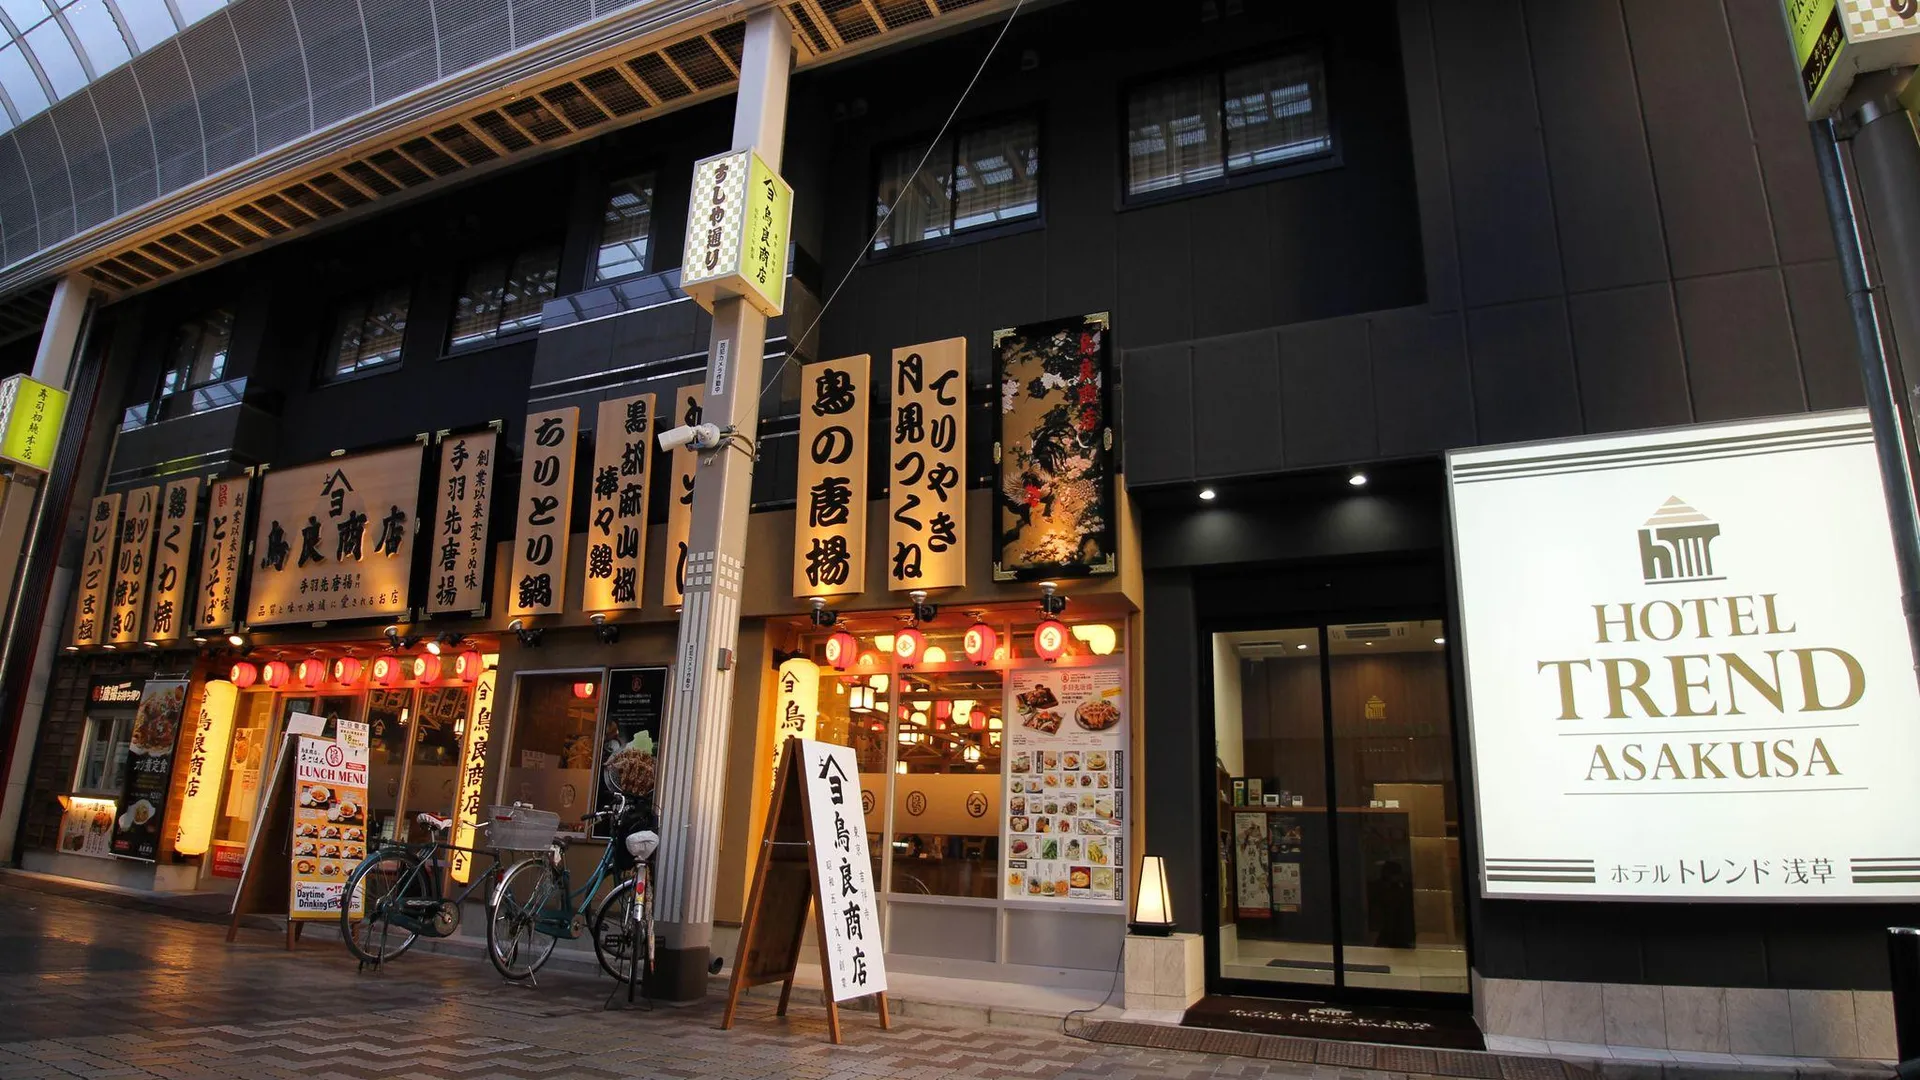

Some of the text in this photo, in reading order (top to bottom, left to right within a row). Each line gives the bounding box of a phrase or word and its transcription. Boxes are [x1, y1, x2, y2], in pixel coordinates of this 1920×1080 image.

[705, 163, 729, 271] すしや通り
[756, 204, 773, 284] 鳥良商店
[518, 416, 565, 608] ちりとり鍋
[611, 400, 647, 603] 黒胡麻山椒
[805, 367, 856, 587] 鳥の唐揚
[892, 352, 925, 581] 月見つくね
[927, 369, 959, 553] てりやき
[201, 515, 228, 624] とりそば
[261, 505, 407, 572] 鳥良商店
[435, 439, 469, 606] 手羽先唐揚
[589, 465, 619, 579] 棒々鶏
[300, 573, 353, 594] 手羽先唐揚
[1591, 593, 1797, 643] HOTEL
[1537, 647, 1866, 721] TREND
[184, 709, 212, 797] 鳥良商店
[300, 765, 335, 780] LUNCH
[338, 770, 367, 785] MENU
[463, 706, 491, 815] 鳥良商店
[1584, 737, 1843, 781] ASAKUSA
[297, 889, 325, 900] Daytime
[299, 899, 327, 910] Drinking
[833, 811, 867, 987] 鳥良商店
